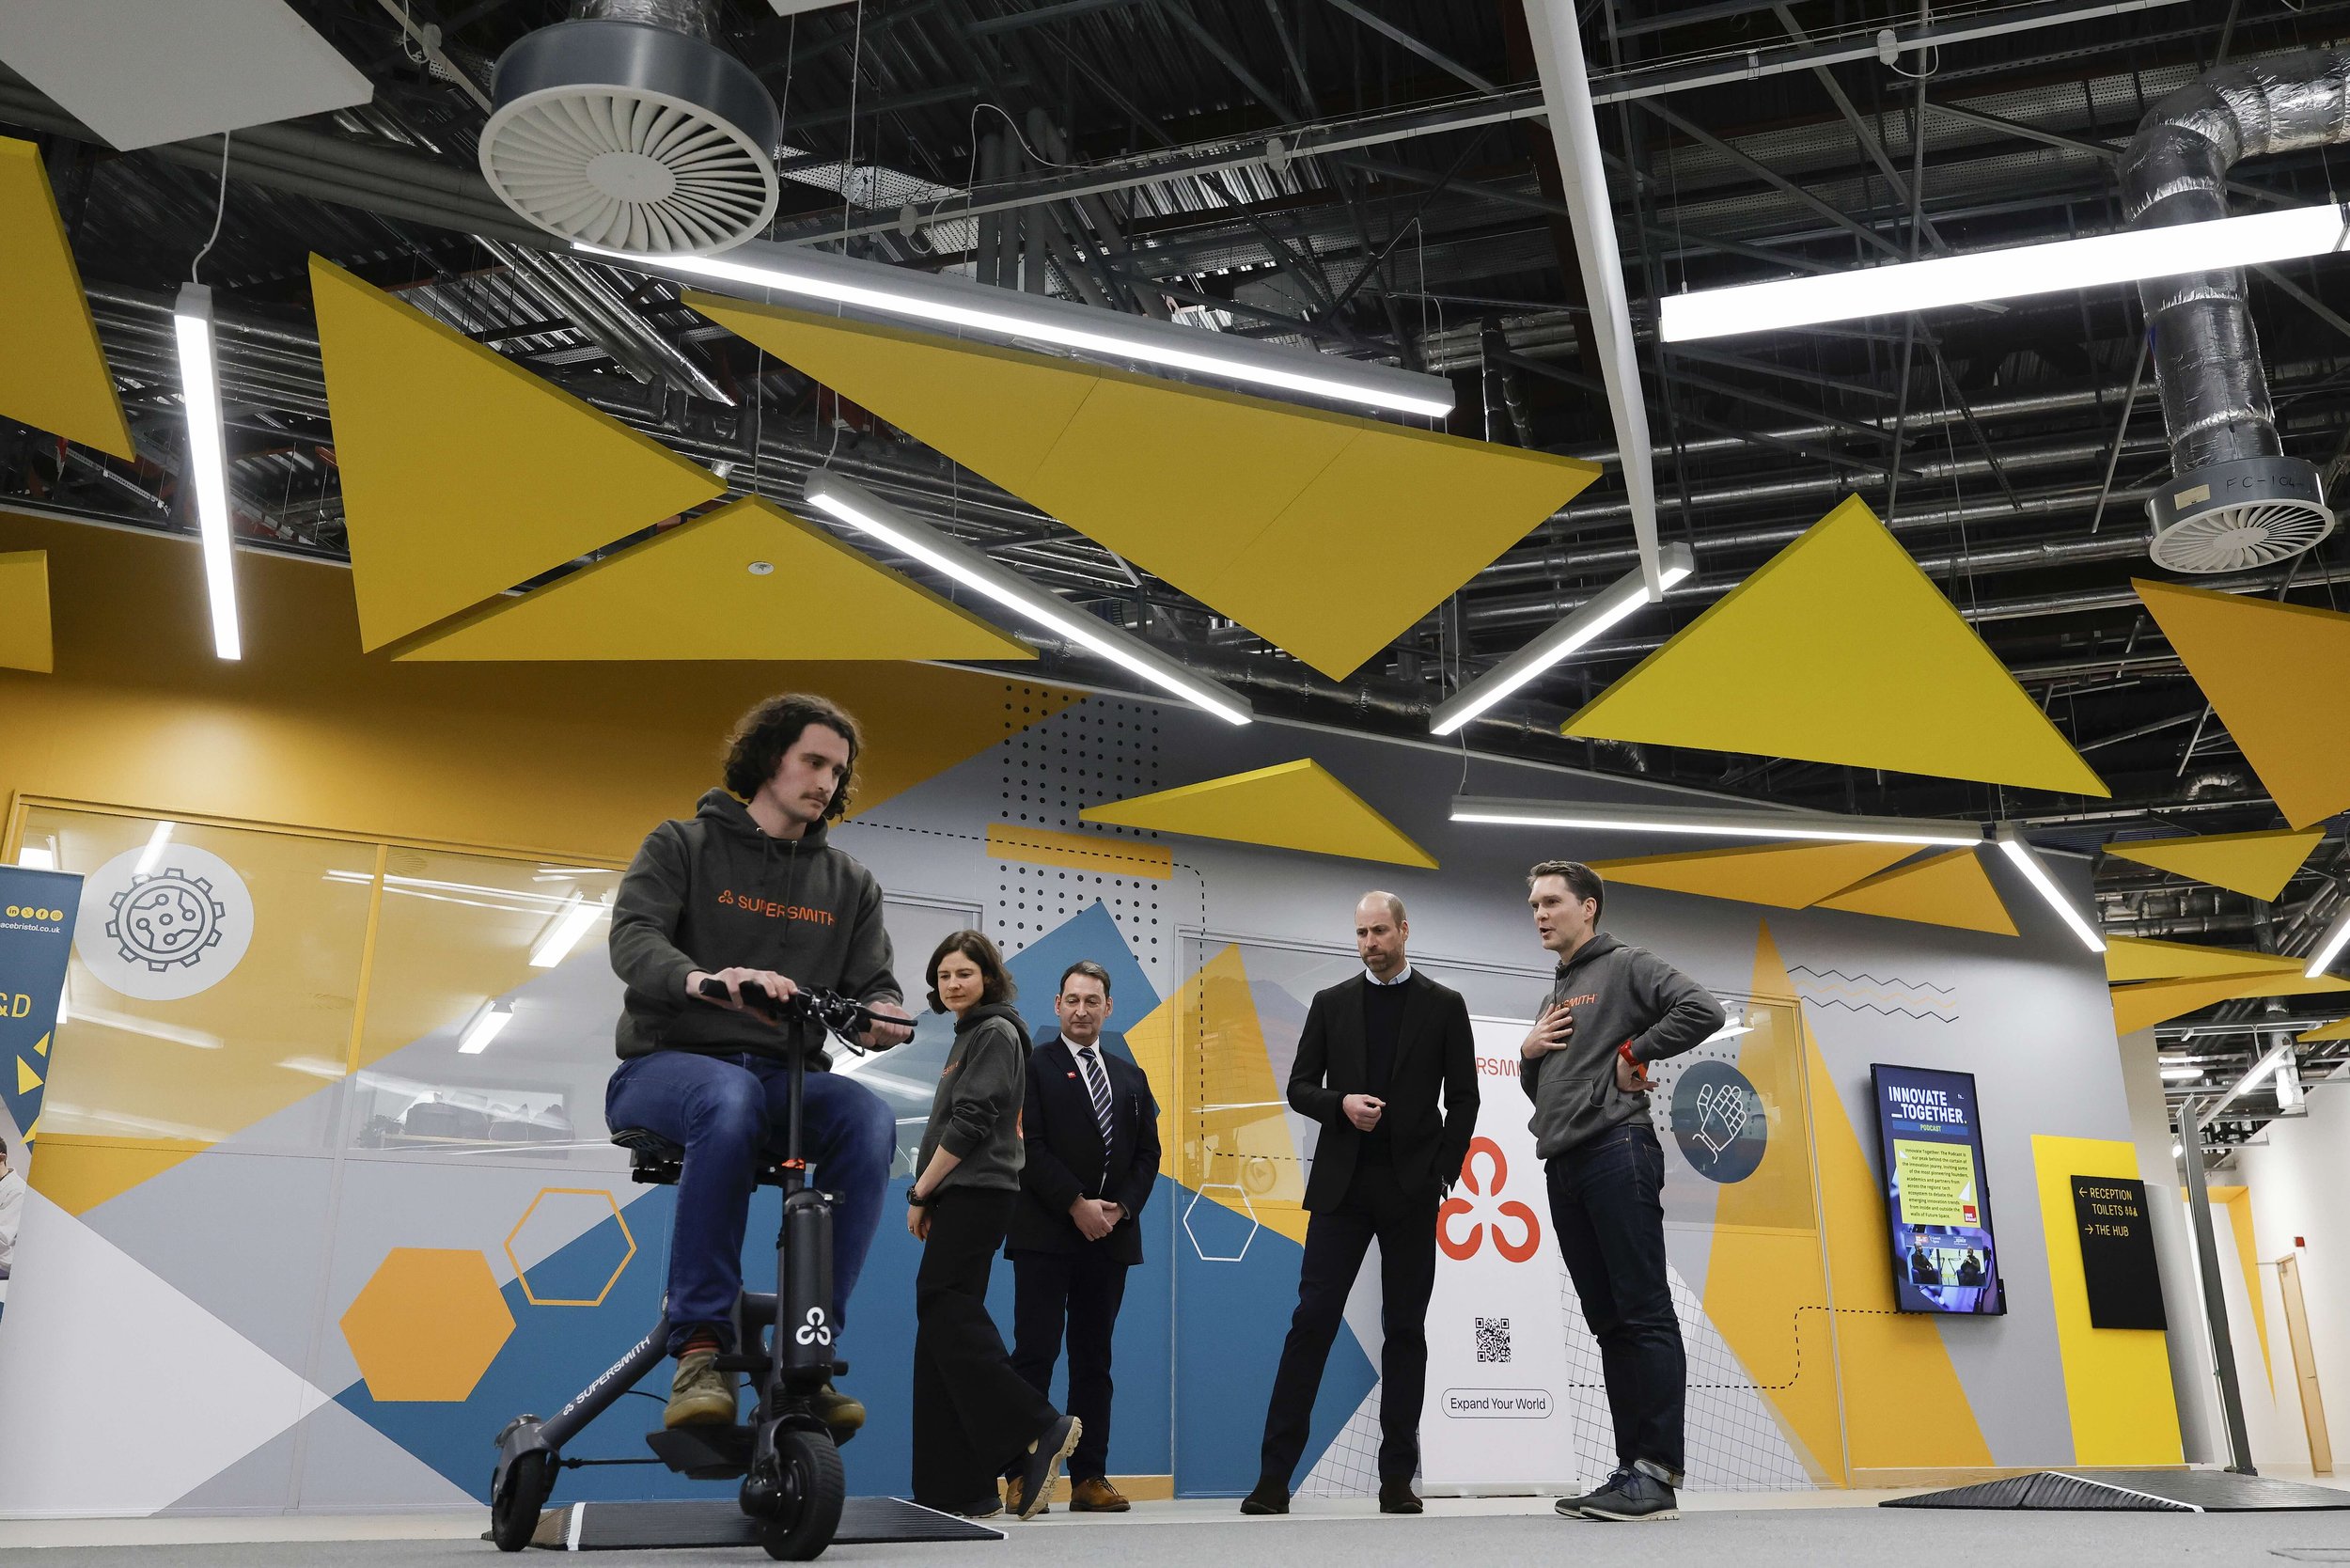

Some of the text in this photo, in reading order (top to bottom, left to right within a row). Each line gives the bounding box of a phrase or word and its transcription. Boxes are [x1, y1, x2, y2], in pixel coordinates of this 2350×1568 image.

[0, 922, 60, 933] acebristol.co.uk
[0, 992, 31, 1017] &D
[1888, 1086, 1947, 1106] INNOVATE
[2090, 1188, 2132, 1200] RECEPTION
[2092, 1203, 2123, 1216] TOILETS
[2095, 1224, 2129, 1237] THE HUB
[576, 1336, 650, 1404] SUPERSMITH
[1450, 1397, 1546, 1411] Expand Your World
